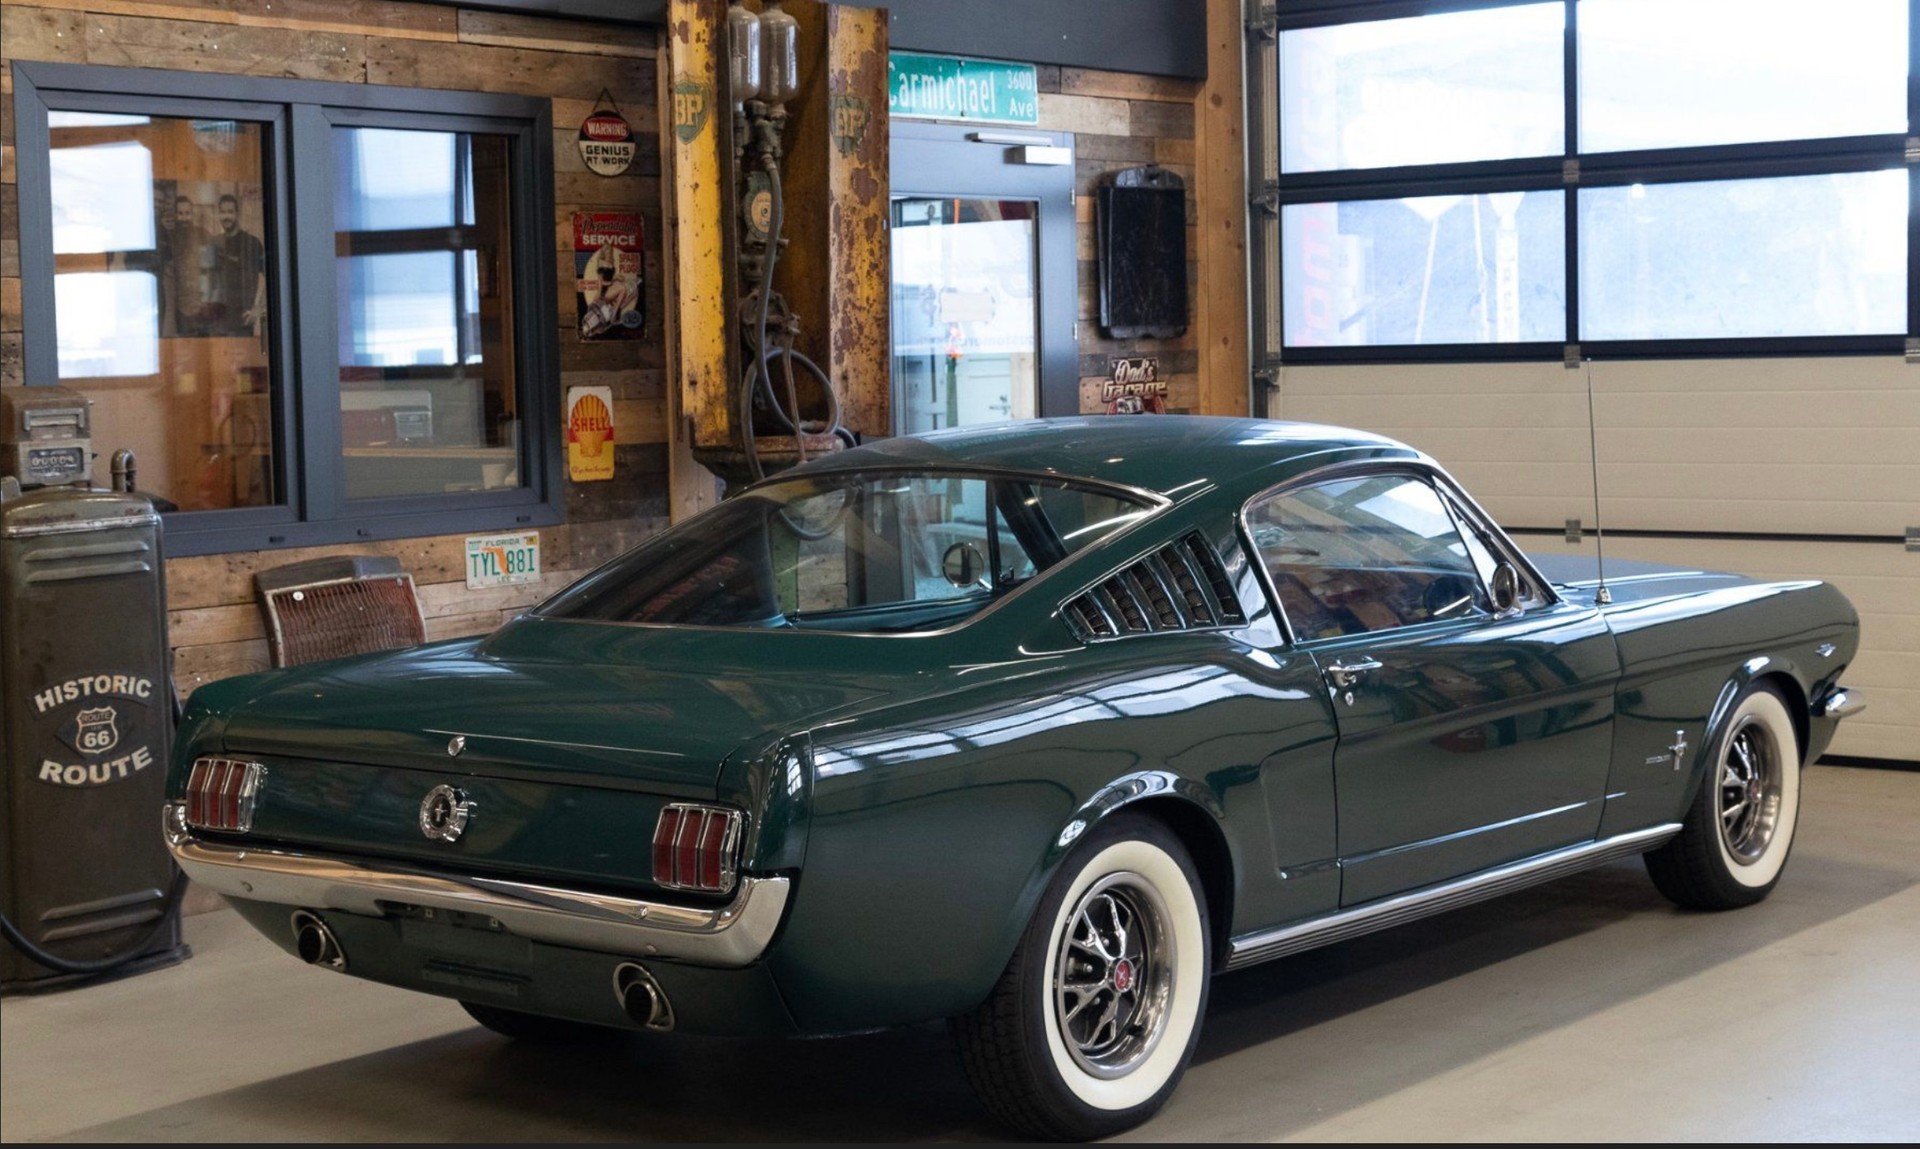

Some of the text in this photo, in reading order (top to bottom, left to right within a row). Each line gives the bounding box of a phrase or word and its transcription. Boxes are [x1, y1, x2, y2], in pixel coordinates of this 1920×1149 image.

[1006, 69, 1032, 91] 3600
[674, 94, 703, 126] BP
[1009, 97, 1034, 117] Ave
[587, 122, 628, 136] WARNING
[834, 107, 863, 136] BP
[586, 145, 629, 155] GENIUS
[602, 157, 630, 165] WORK
[582, 234, 636, 246] SERVICE
[1114, 359, 1154, 384] Dad's
[1103, 381, 1167, 400] Garage
[574, 417, 608, 432] SHELL
[486, 538, 520, 546] FLORIDA
[34, 674, 152, 712] HISTORIC
[81, 712, 110, 721] ROUTE
[84, 730, 110, 748] 66
[39, 745, 153, 785] ROUTE
